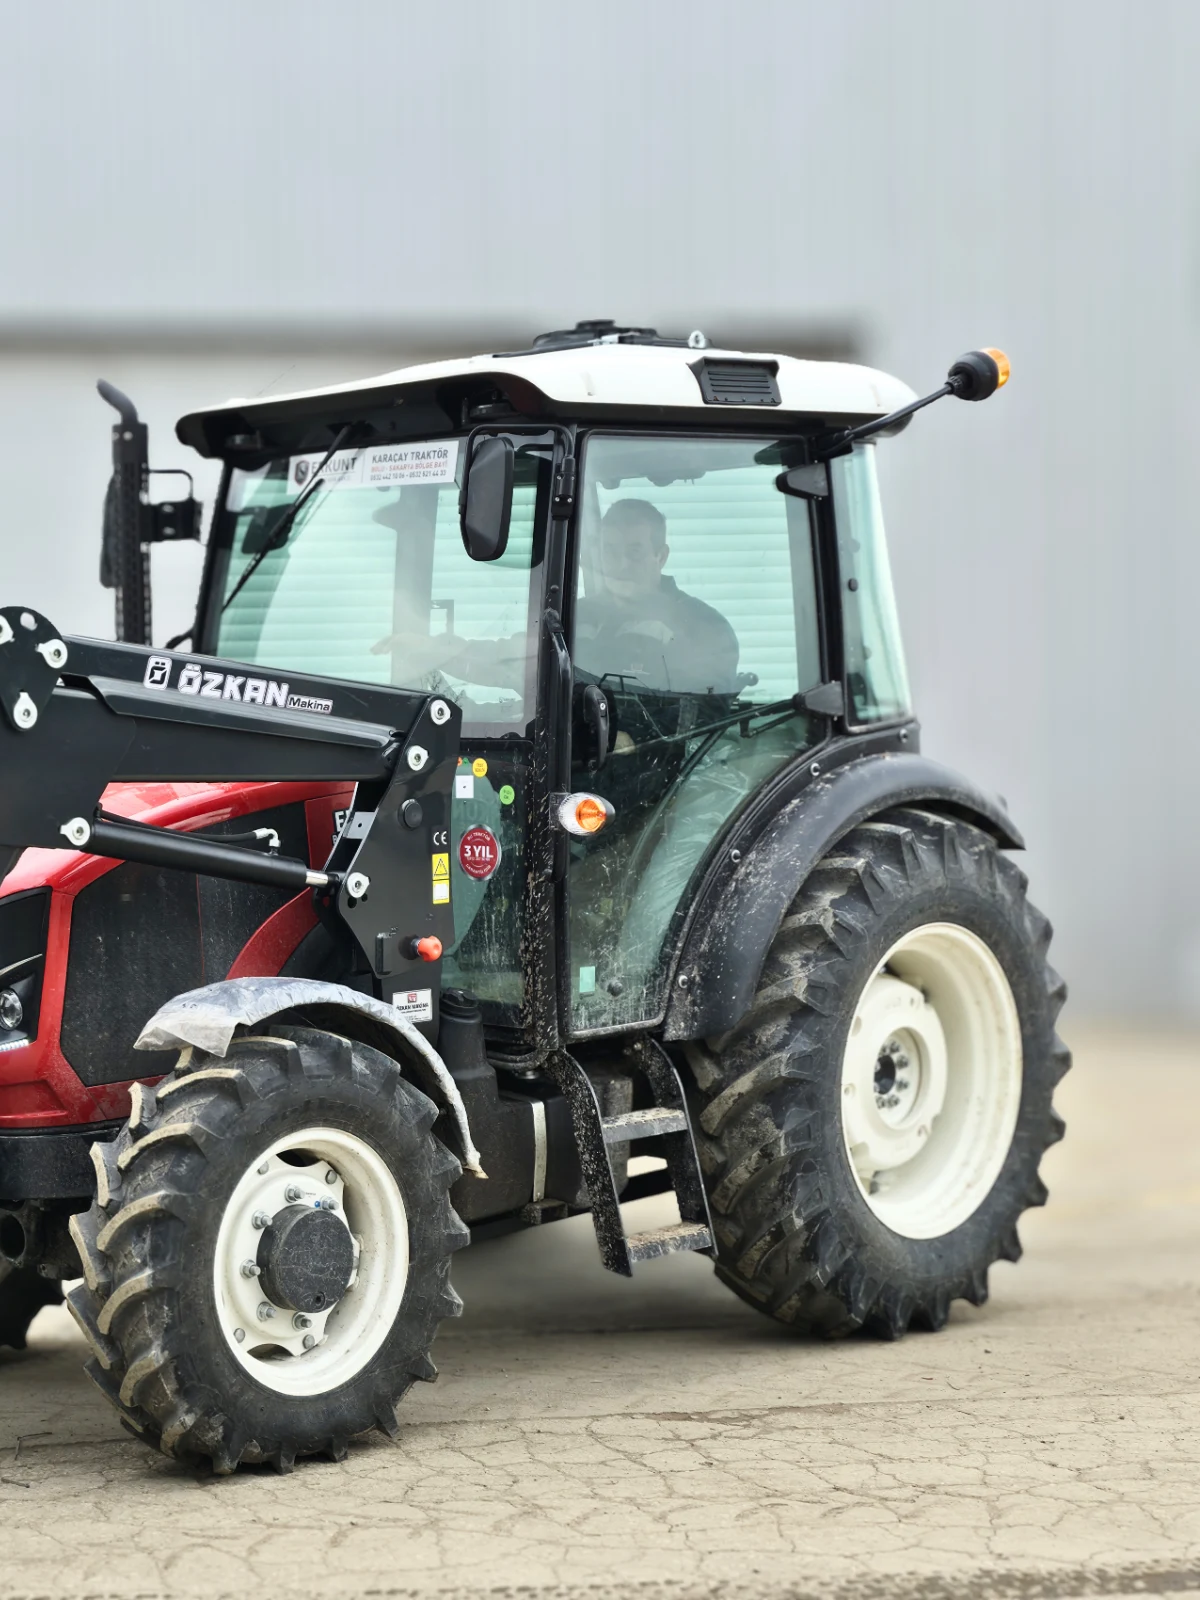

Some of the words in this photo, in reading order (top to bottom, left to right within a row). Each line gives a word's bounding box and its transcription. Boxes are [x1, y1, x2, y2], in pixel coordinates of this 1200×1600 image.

[372, 451, 409, 464] KARAÇAY
[411, 447, 449, 460] TRAKTÖR
[389, 462, 414, 472] SAKARYA
[415, 461, 433, 470] BÖLGE
[177, 663, 289, 708] ÖZKAN
[288, 697, 331, 712] Makina
[464, 844, 472, 858] 3
[472, 845, 495, 859] YIL
